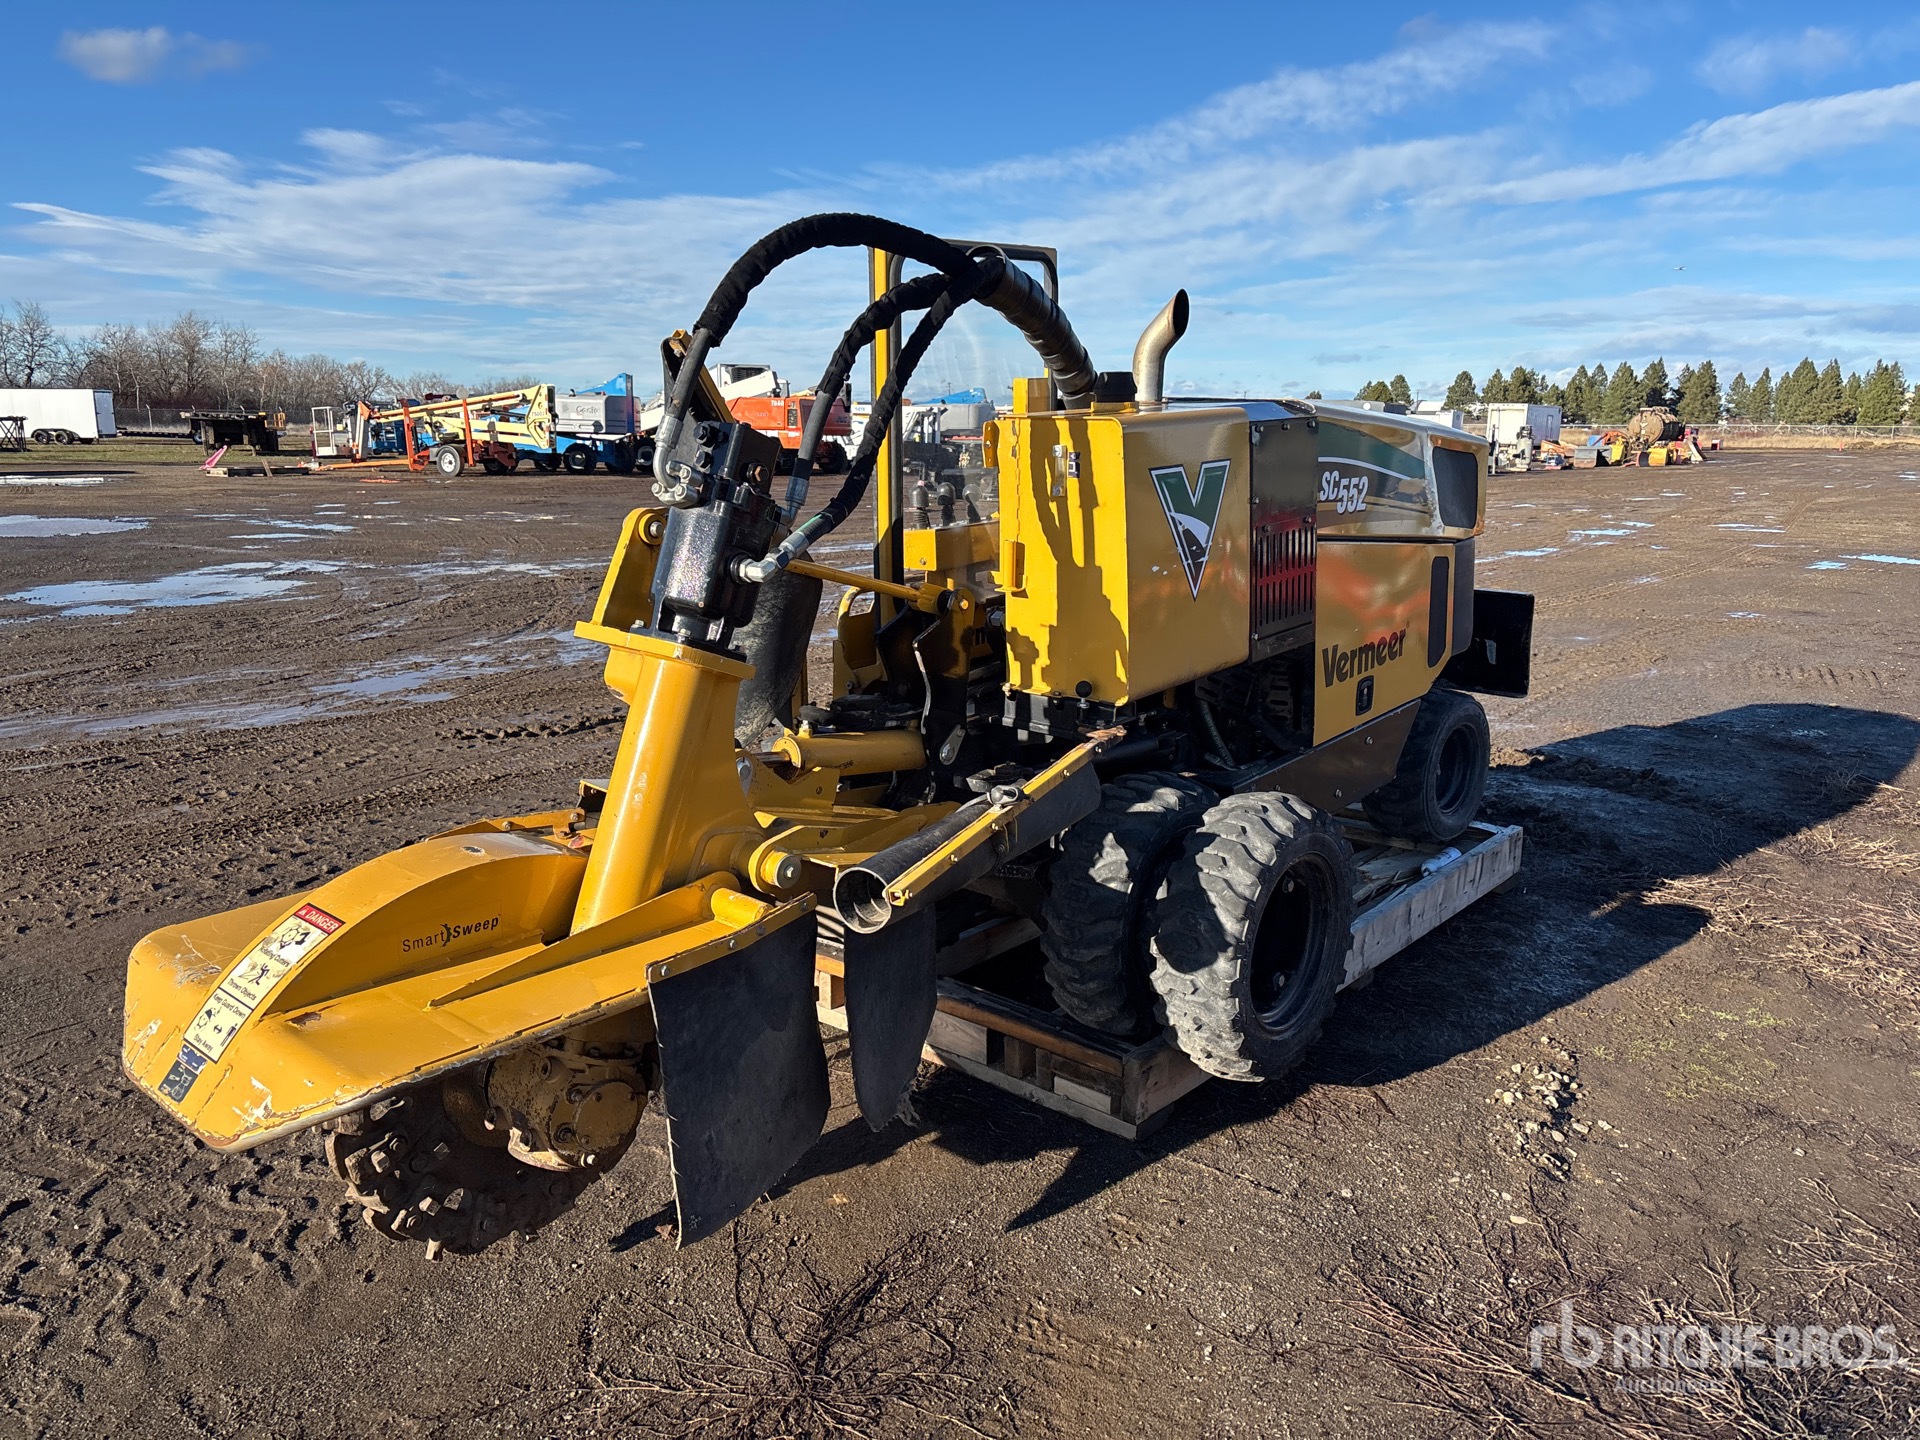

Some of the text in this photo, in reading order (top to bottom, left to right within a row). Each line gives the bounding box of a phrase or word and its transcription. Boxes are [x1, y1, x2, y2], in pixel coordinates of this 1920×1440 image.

[575, 405, 599, 414] Genie
[1322, 628, 1407, 688] Vermeer
[305, 910, 339, 933] DANGER
[227, 978, 257, 1001] Thrown Objects
[213, 993, 246, 1019] Keep Guard Down
